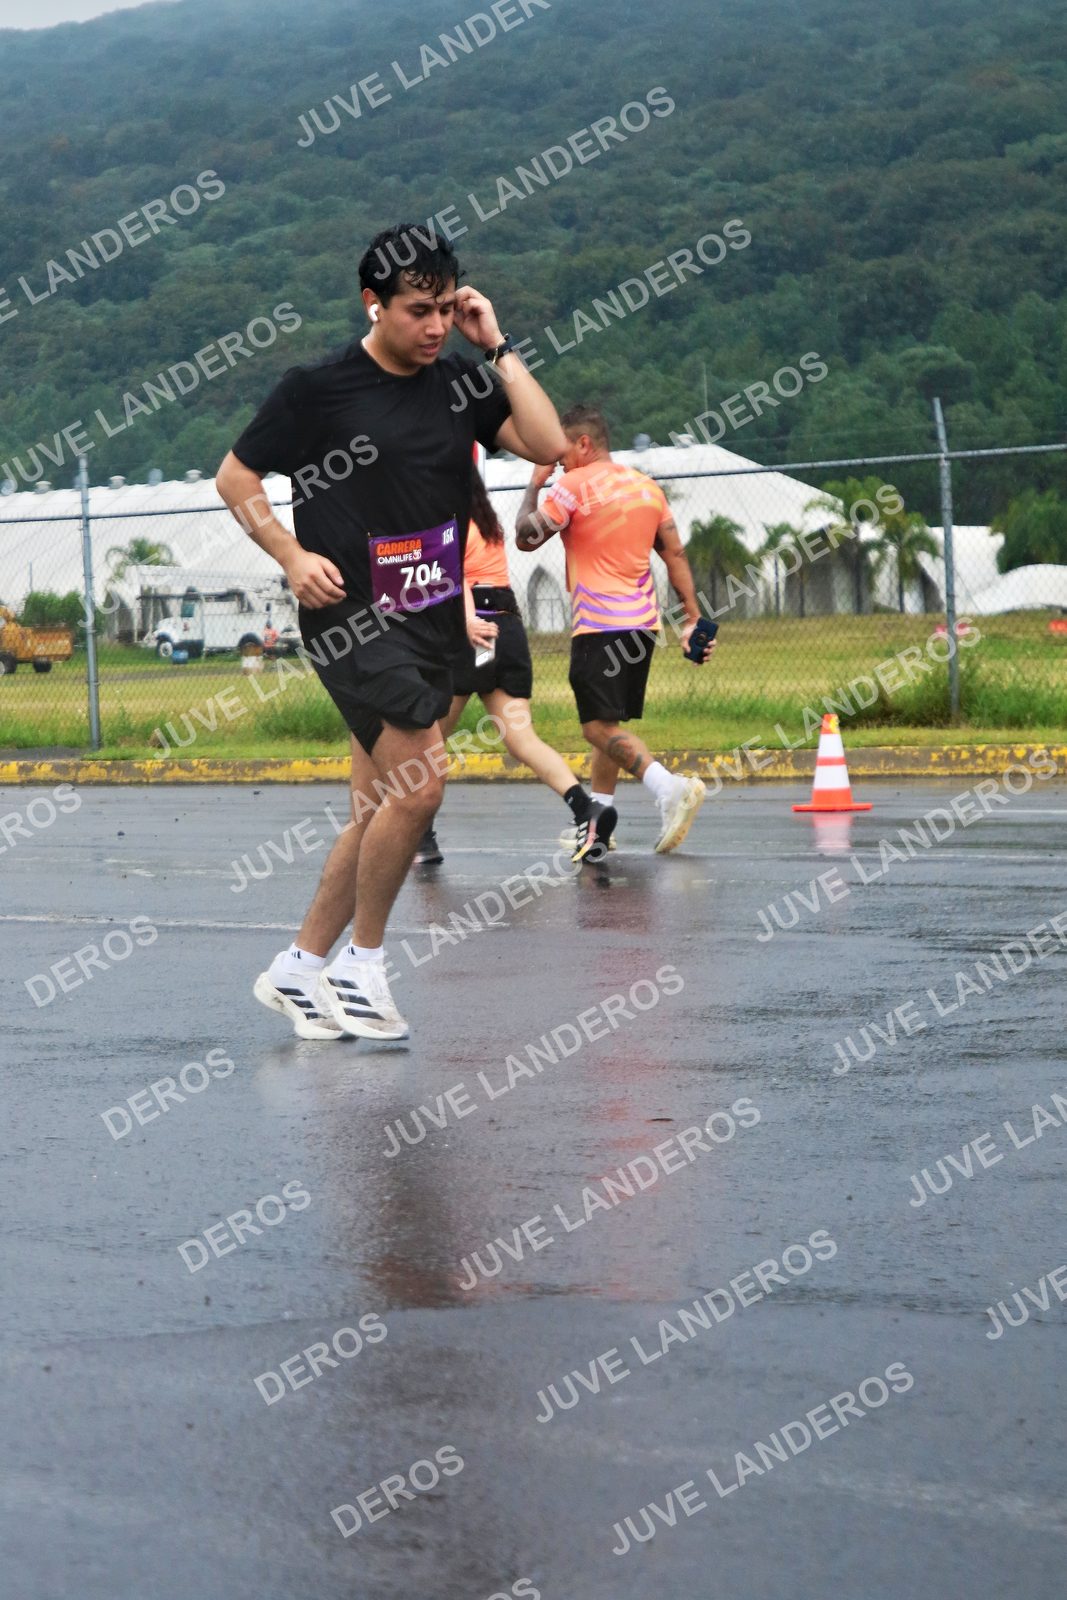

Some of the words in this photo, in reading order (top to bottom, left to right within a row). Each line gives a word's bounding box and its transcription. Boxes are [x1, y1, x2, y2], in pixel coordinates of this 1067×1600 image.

[376, 539, 422, 556] CARRERA
[377, 552, 413, 565] OMNILIFE
[400, 560, 442, 588] 704
